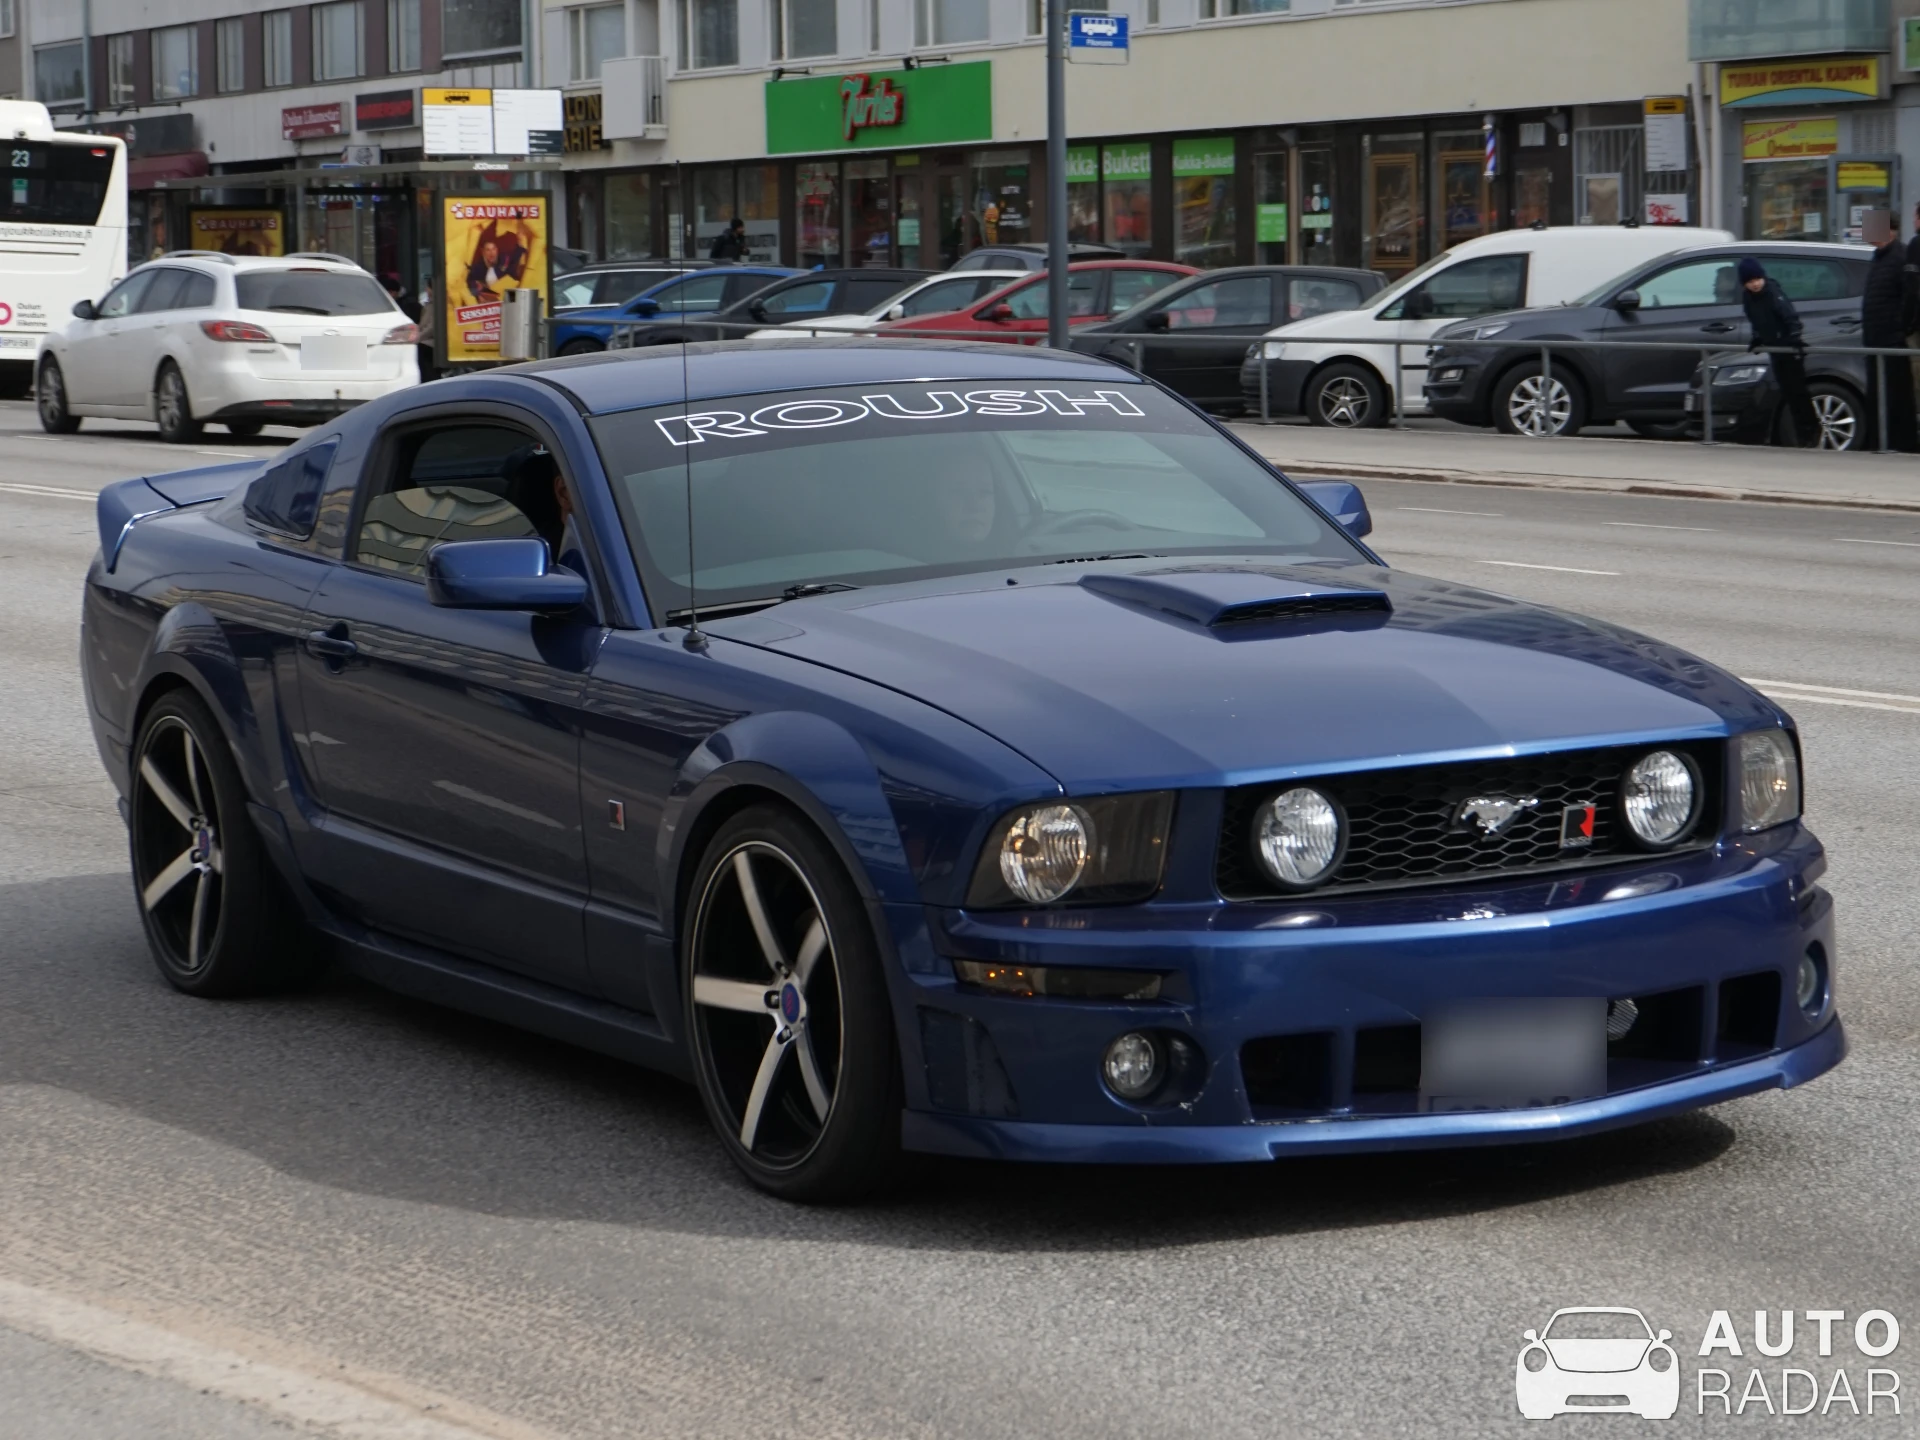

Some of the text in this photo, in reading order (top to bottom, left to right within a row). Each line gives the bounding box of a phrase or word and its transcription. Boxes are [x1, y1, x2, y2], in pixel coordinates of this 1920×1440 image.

[1727, 65, 1870, 88] TUIRAN ORIENTAL KAUPPA
[840, 73, 904, 141] Turtles
[11, 149, 30, 168] 23
[1065, 152, 1098, 176] kka-
[465, 205, 540, 219] BAUHAUS
[654, 389, 1146, 446] ROUSH
